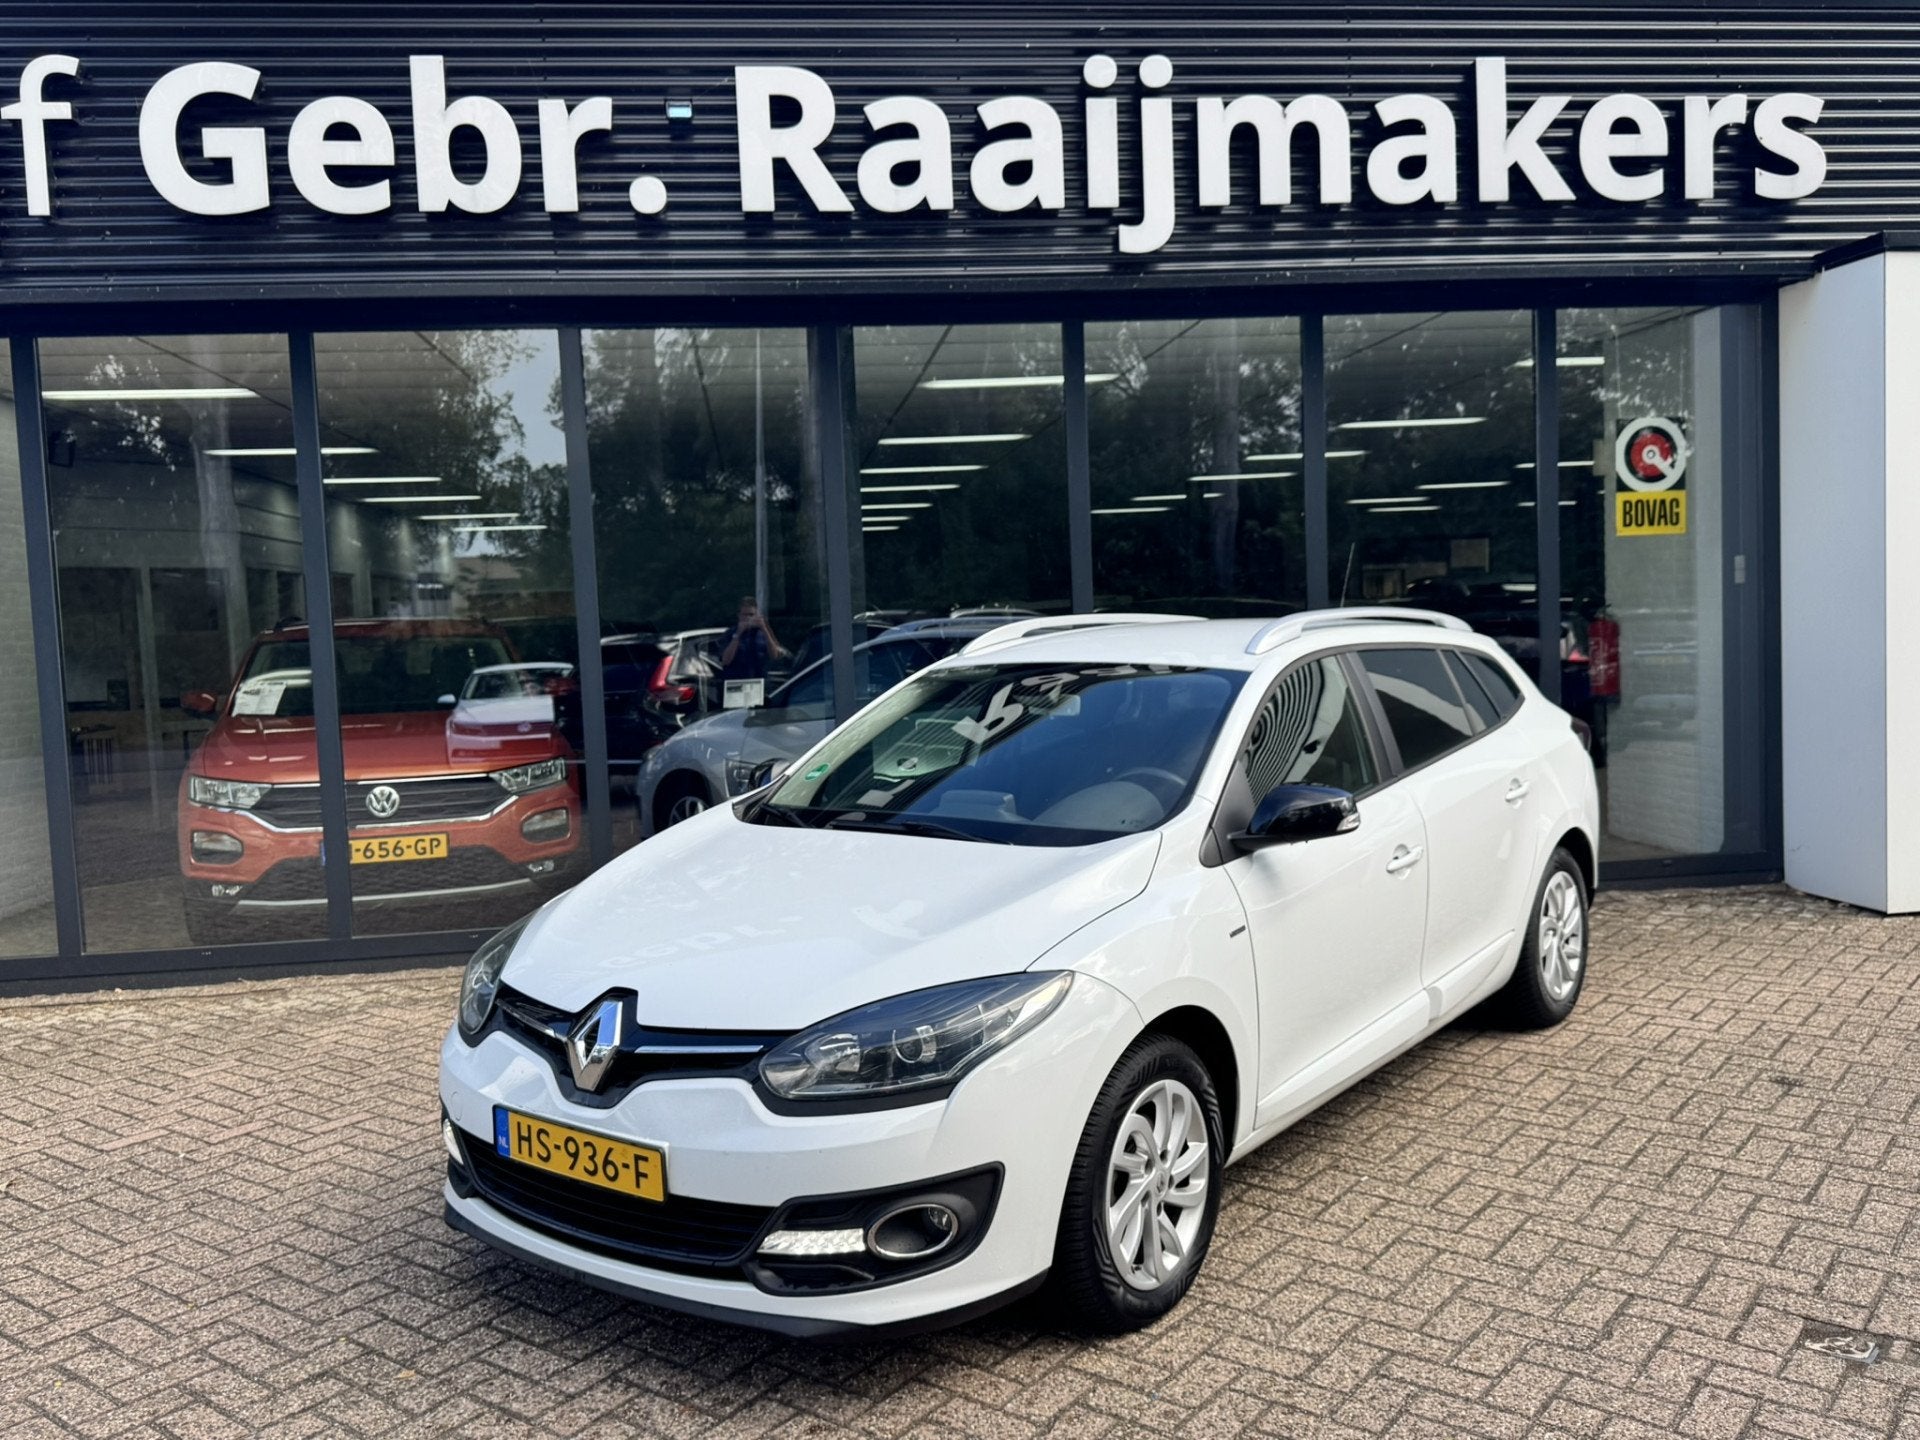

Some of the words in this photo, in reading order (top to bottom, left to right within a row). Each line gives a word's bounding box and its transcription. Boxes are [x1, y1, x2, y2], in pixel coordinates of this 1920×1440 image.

[138, 55, 667, 215] Gebr.
[735, 54, 1827, 253] Raaijmakers
[1622, 498, 1680, 527] BOVAG
[349, 838, 441, 859] -656-GP
[516, 1116, 649, 1188] HS-936-F
